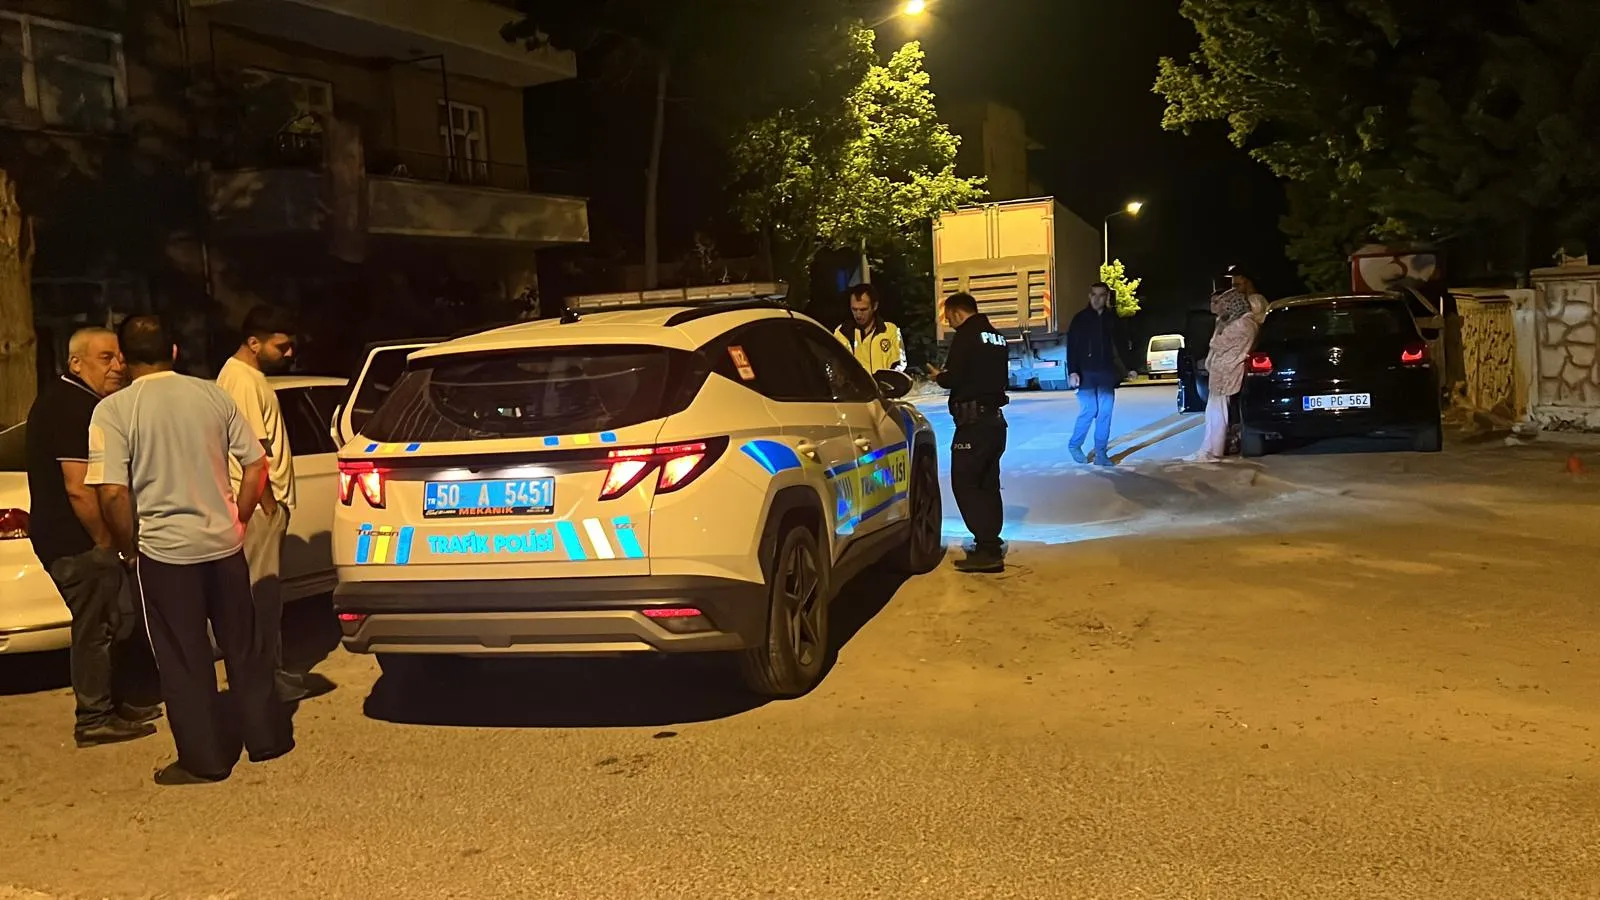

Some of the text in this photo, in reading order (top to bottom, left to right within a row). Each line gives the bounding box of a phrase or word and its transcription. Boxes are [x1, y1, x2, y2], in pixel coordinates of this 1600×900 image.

[1310, 395, 1368, 407] 06 PG 562
[437, 480, 550, 507] 50 A 5451
[428, 528, 554, 554] TRAFİK POLİSİ
